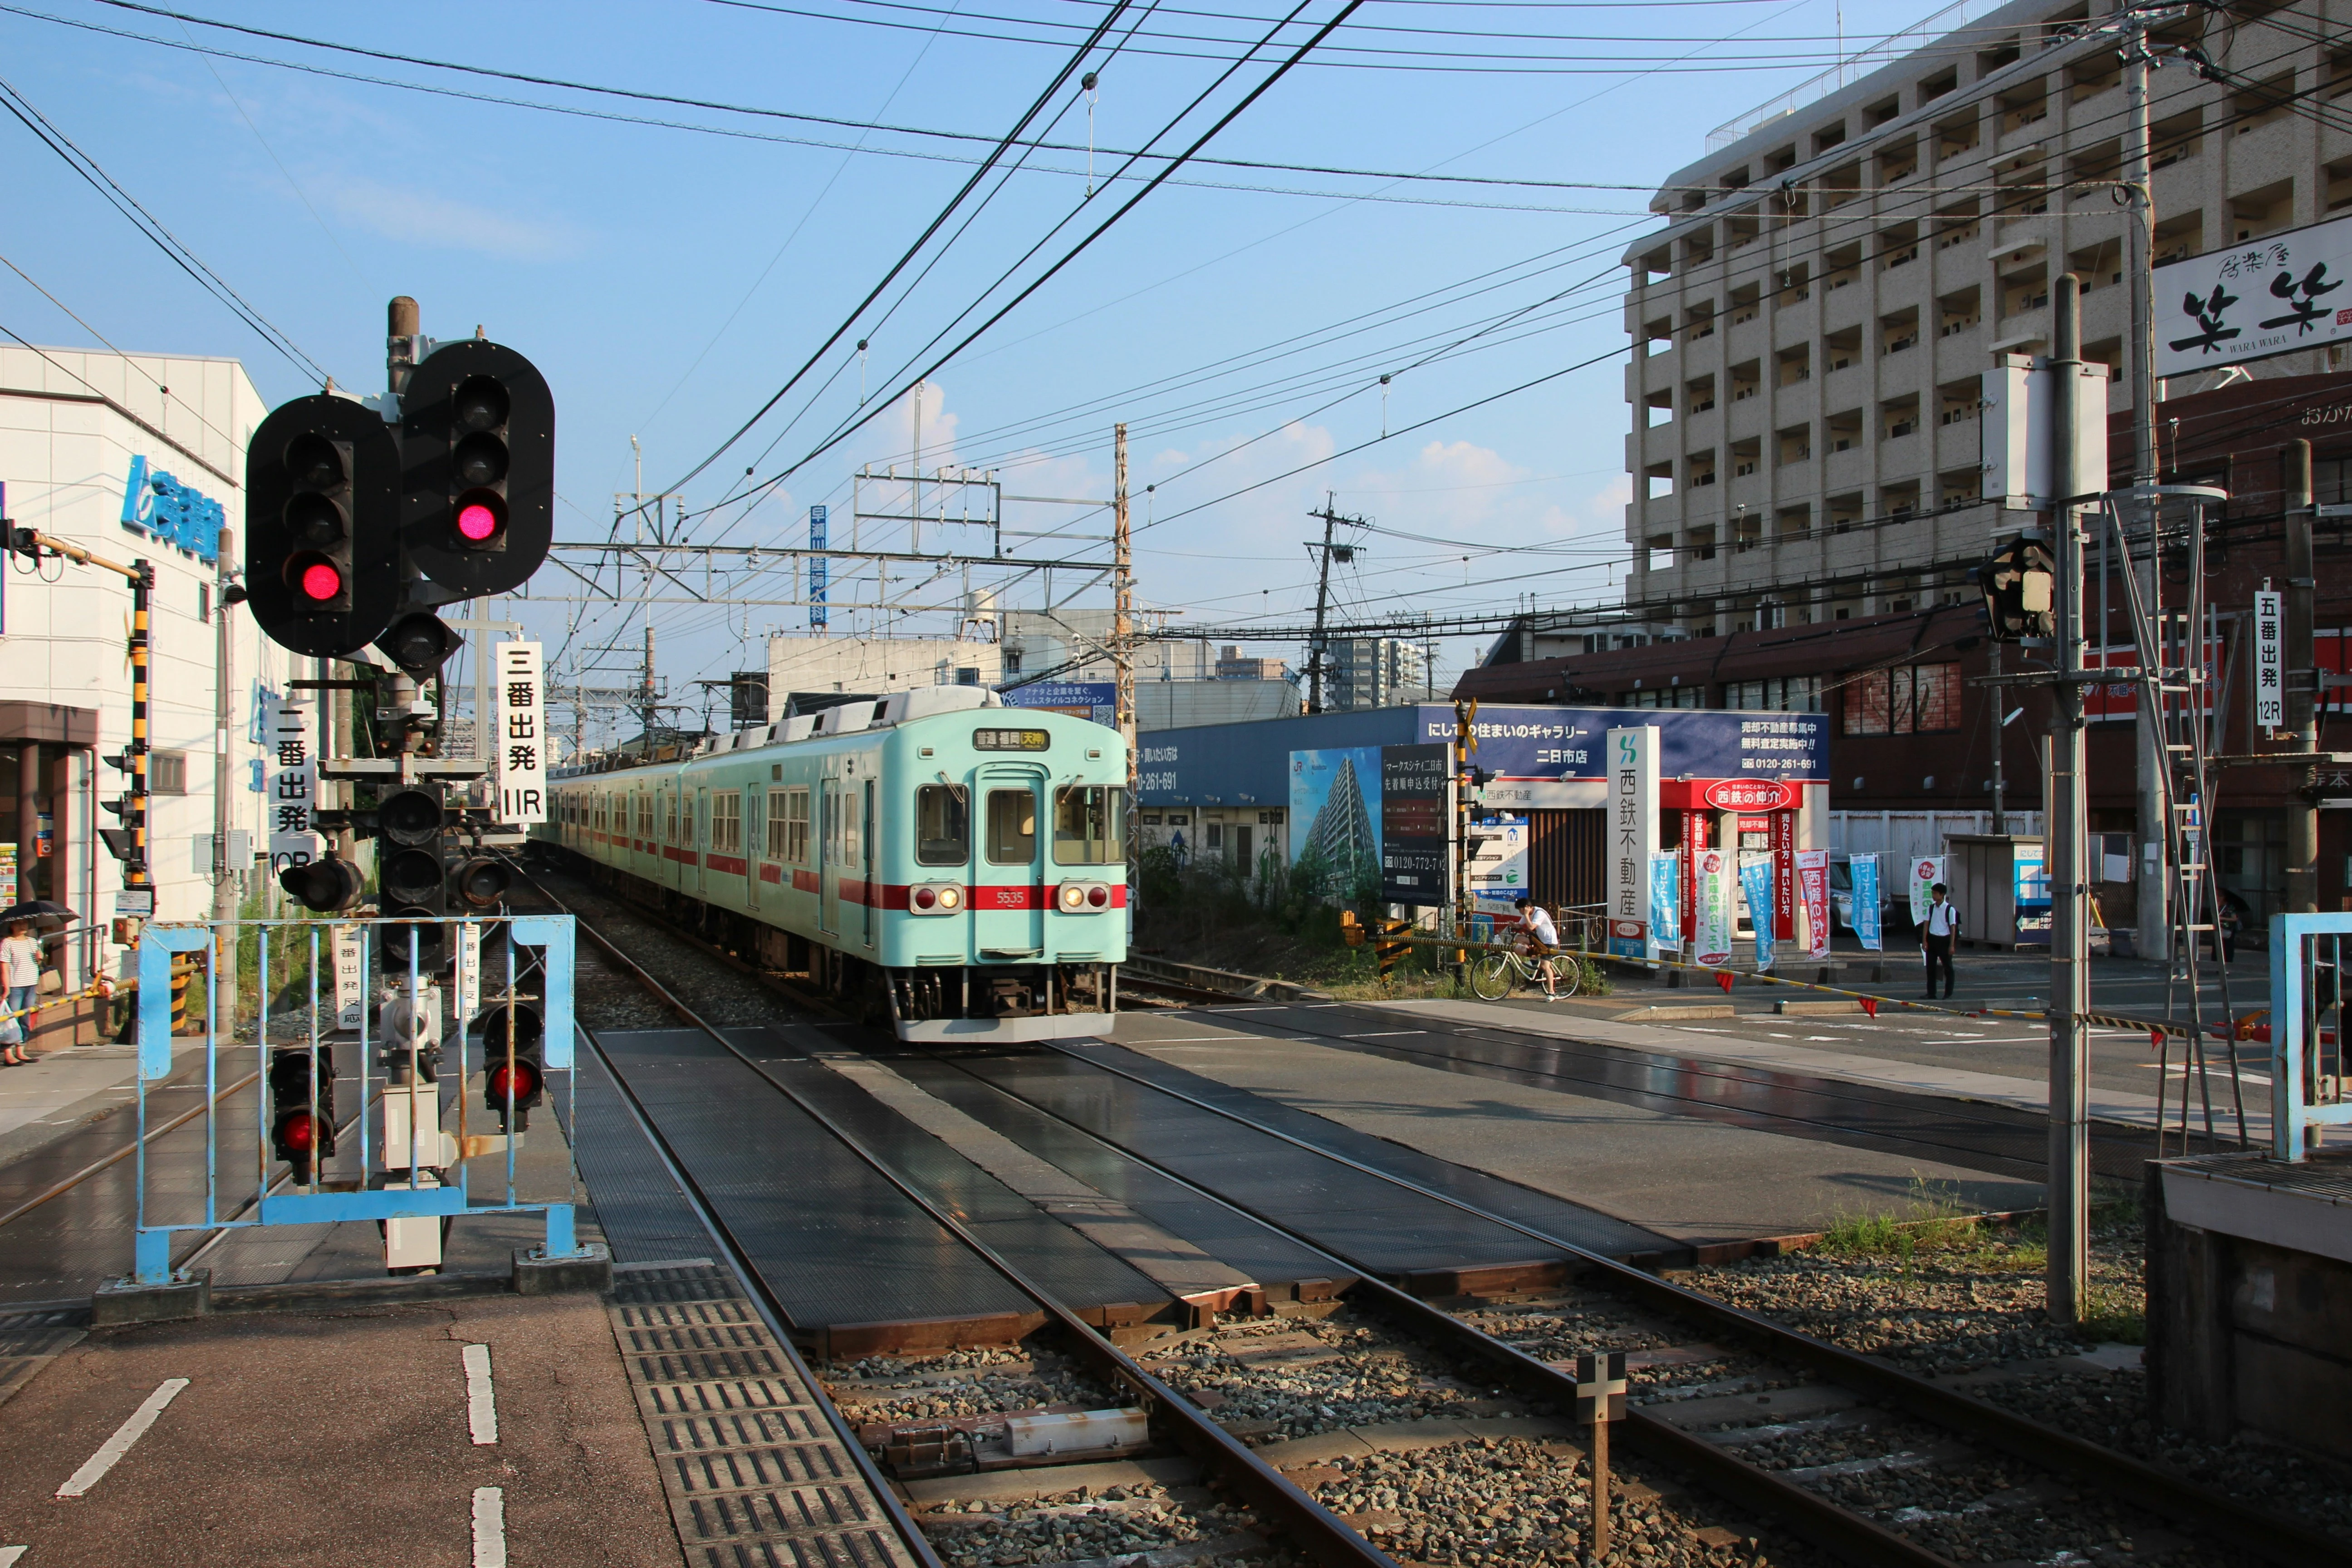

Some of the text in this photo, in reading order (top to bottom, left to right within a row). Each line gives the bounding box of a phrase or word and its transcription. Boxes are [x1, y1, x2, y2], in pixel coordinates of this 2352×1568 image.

[2168, 261, 2344, 355] 笑笑
[2230, 334, 2287, 354] WARA WARA
[2261, 598, 2277, 687] 五番出発
[1024, 696, 1104, 704] エムスタイルコネクション
[507, 651, 536, 771] 三番出発
[2259, 701, 2280, 720] 12R
[1741, 721, 1817, 734] 売却不動産募集中
[977, 731, 997, 745] 普通
[1536, 749, 1588, 764] 二日市店
[1755, 758, 1816, 769] 0120-261-691
[277, 710, 308, 833] 二番出発
[1384, 759, 1446, 772] 「マークスシティ二日市」
[505, 789, 541, 816] 11R
[1486, 790, 1532, 800] 西鉄不動産
[1717, 790, 1780, 804] 西鉄の仲介
[1620, 769, 1636, 916] 西鉄不動産
[1394, 856, 1446, 871] 0120-772-72
[1781, 813, 1790, 918] 売りたい方・買いたい方、
[997, 892, 1024, 904] 5535
[340, 932, 360, 1024] 二番出発反応
